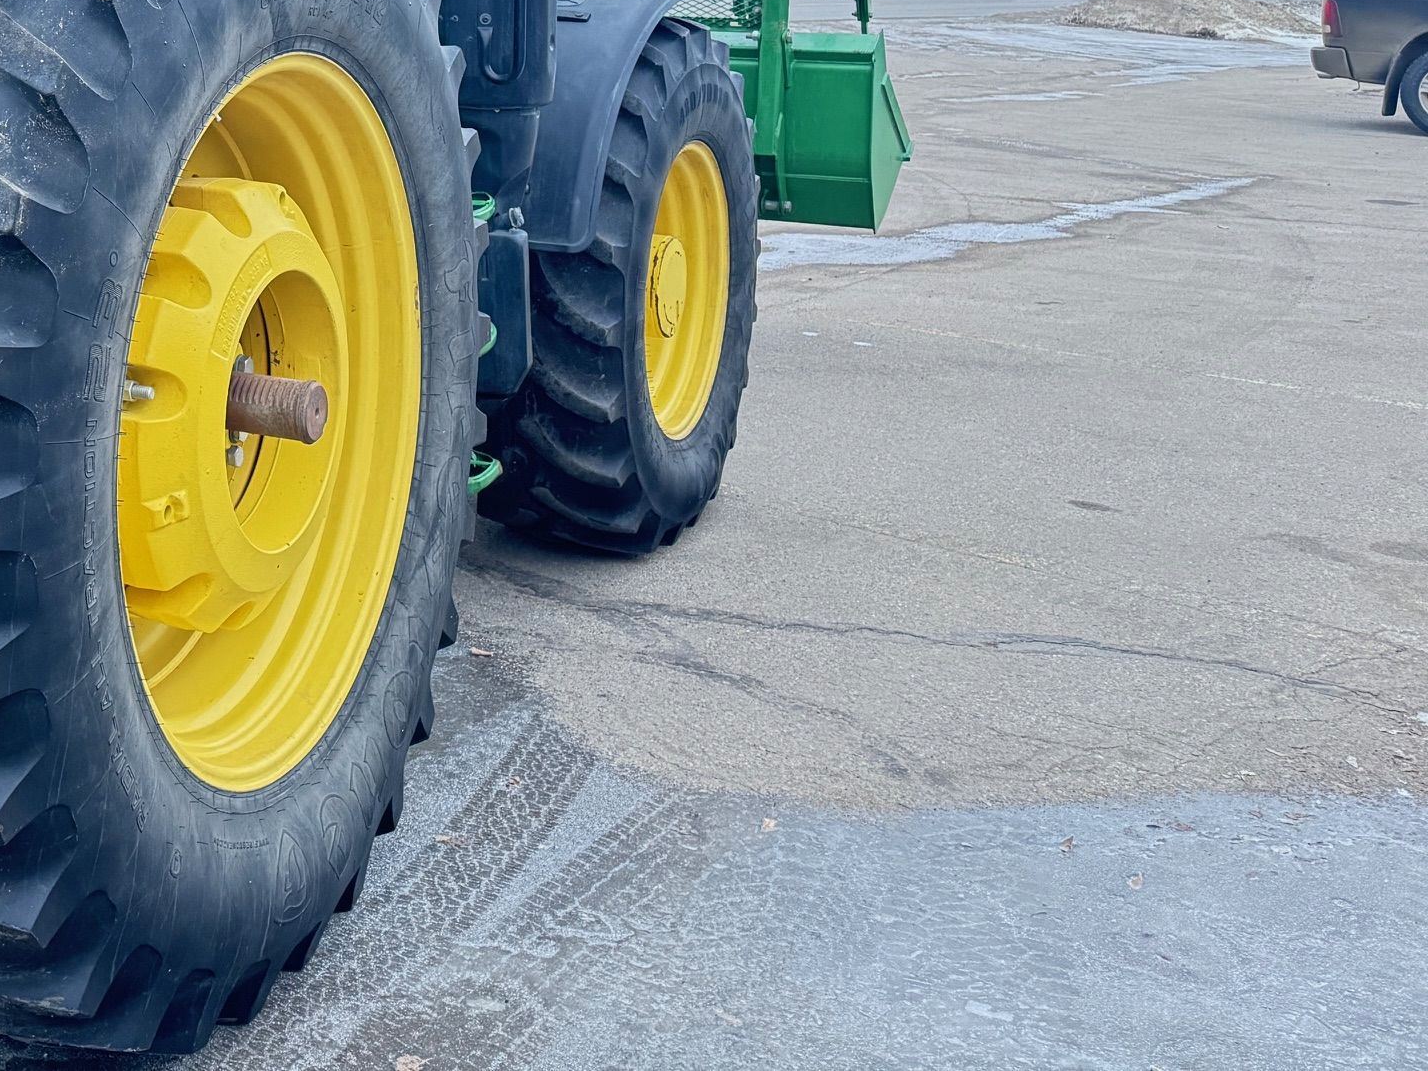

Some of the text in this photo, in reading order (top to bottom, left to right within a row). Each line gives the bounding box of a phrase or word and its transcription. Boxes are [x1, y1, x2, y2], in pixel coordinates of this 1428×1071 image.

[81, 417, 102, 638] TRACTION
[88, 637, 114, 715] ALL
[104, 718, 150, 834] RADIAL
